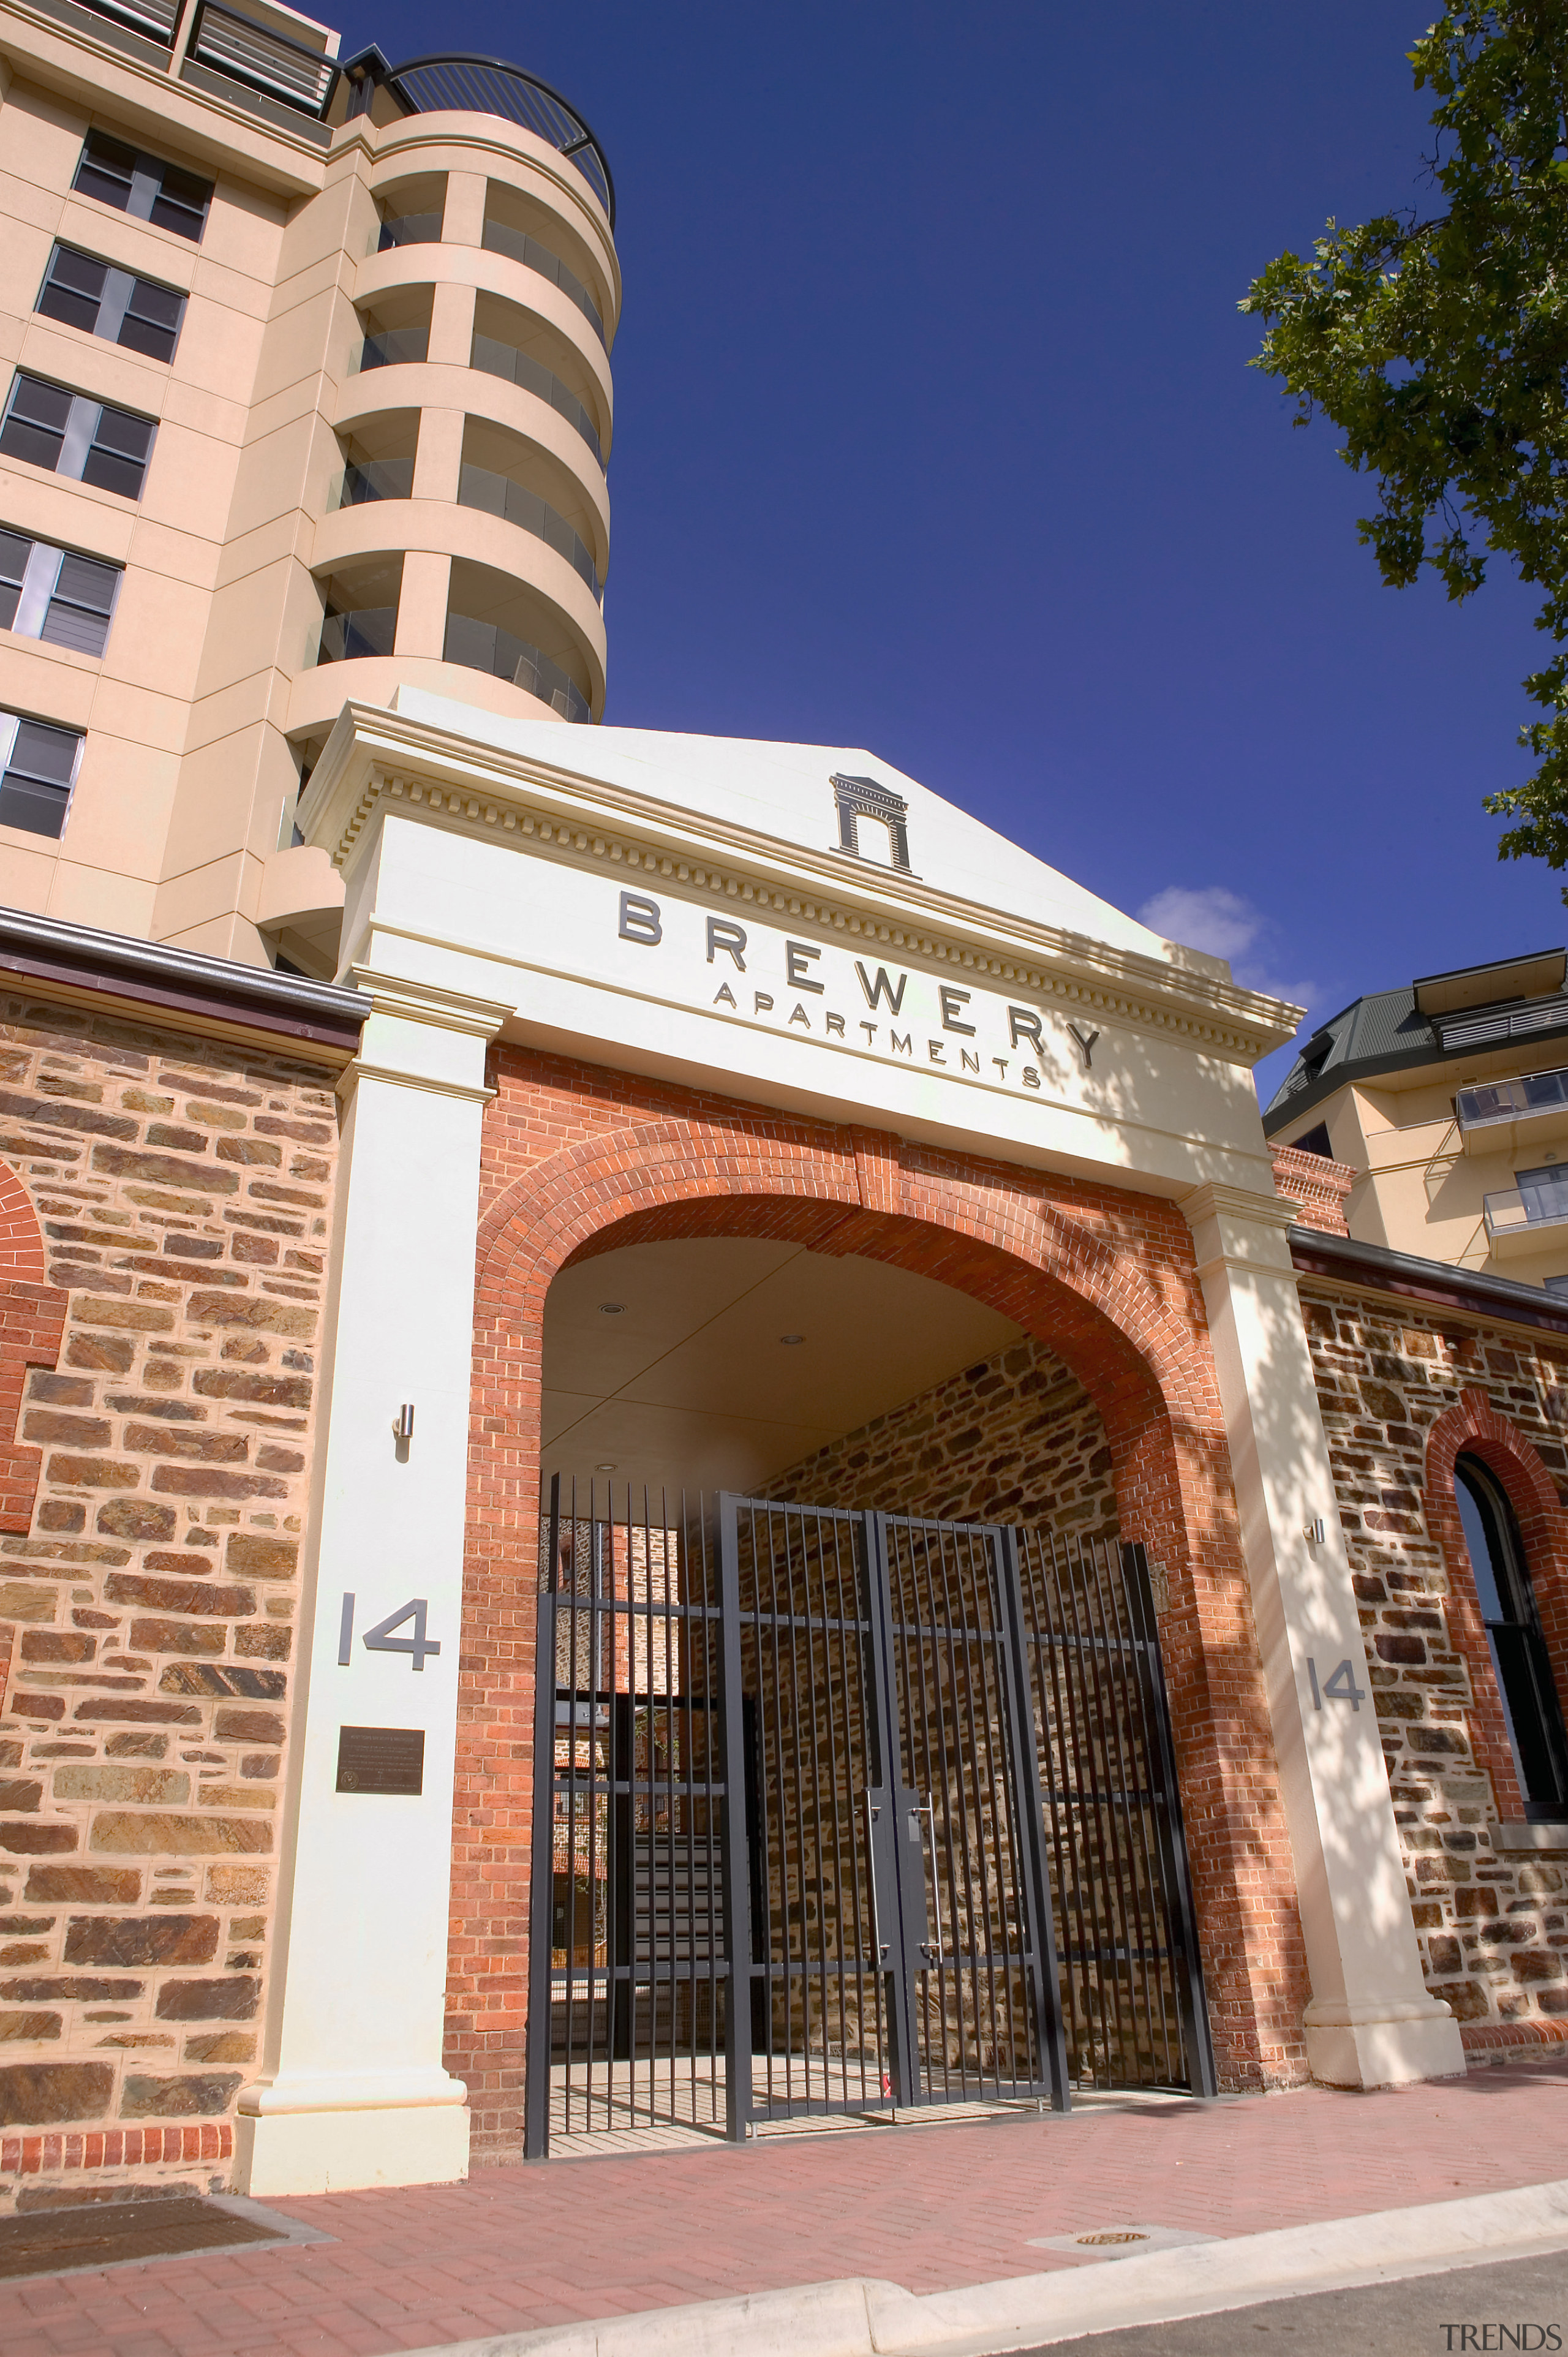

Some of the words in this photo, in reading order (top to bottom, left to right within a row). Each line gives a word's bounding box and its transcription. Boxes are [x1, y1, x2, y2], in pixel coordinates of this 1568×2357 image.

[618, 891, 1100, 1068] BREWERY
[713, 982, 1041, 1089] APARTMENTS
[338, 1592, 441, 1672] 14
[1307, 1657, 1366, 1711] 14
